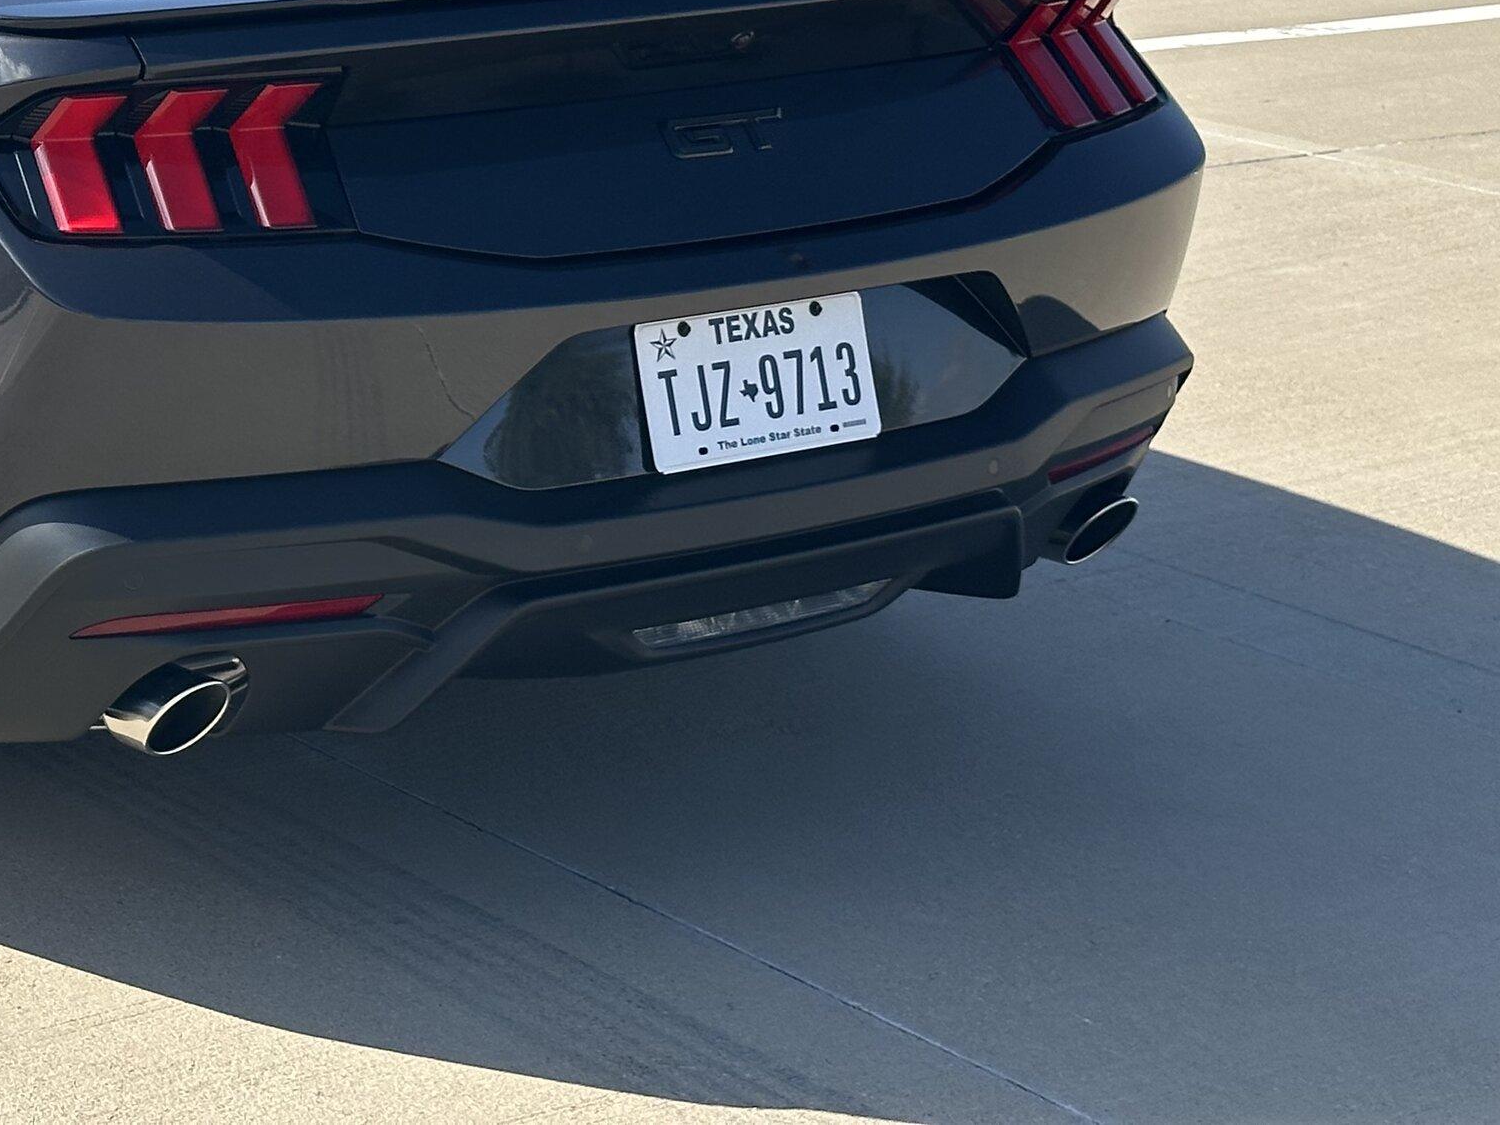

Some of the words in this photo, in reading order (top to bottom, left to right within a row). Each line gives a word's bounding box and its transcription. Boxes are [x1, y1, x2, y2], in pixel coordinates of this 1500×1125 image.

[658, 107, 784, 161] GT
[708, 306, 796, 346] TEXAS
[656, 360, 741, 437] TJZ
[758, 341, 863, 420] 9713
[716, 439, 739, 451] The
[740, 434, 767, 448] Lone
[768, 430, 792, 442] Star
[793, 425, 823, 438] State
